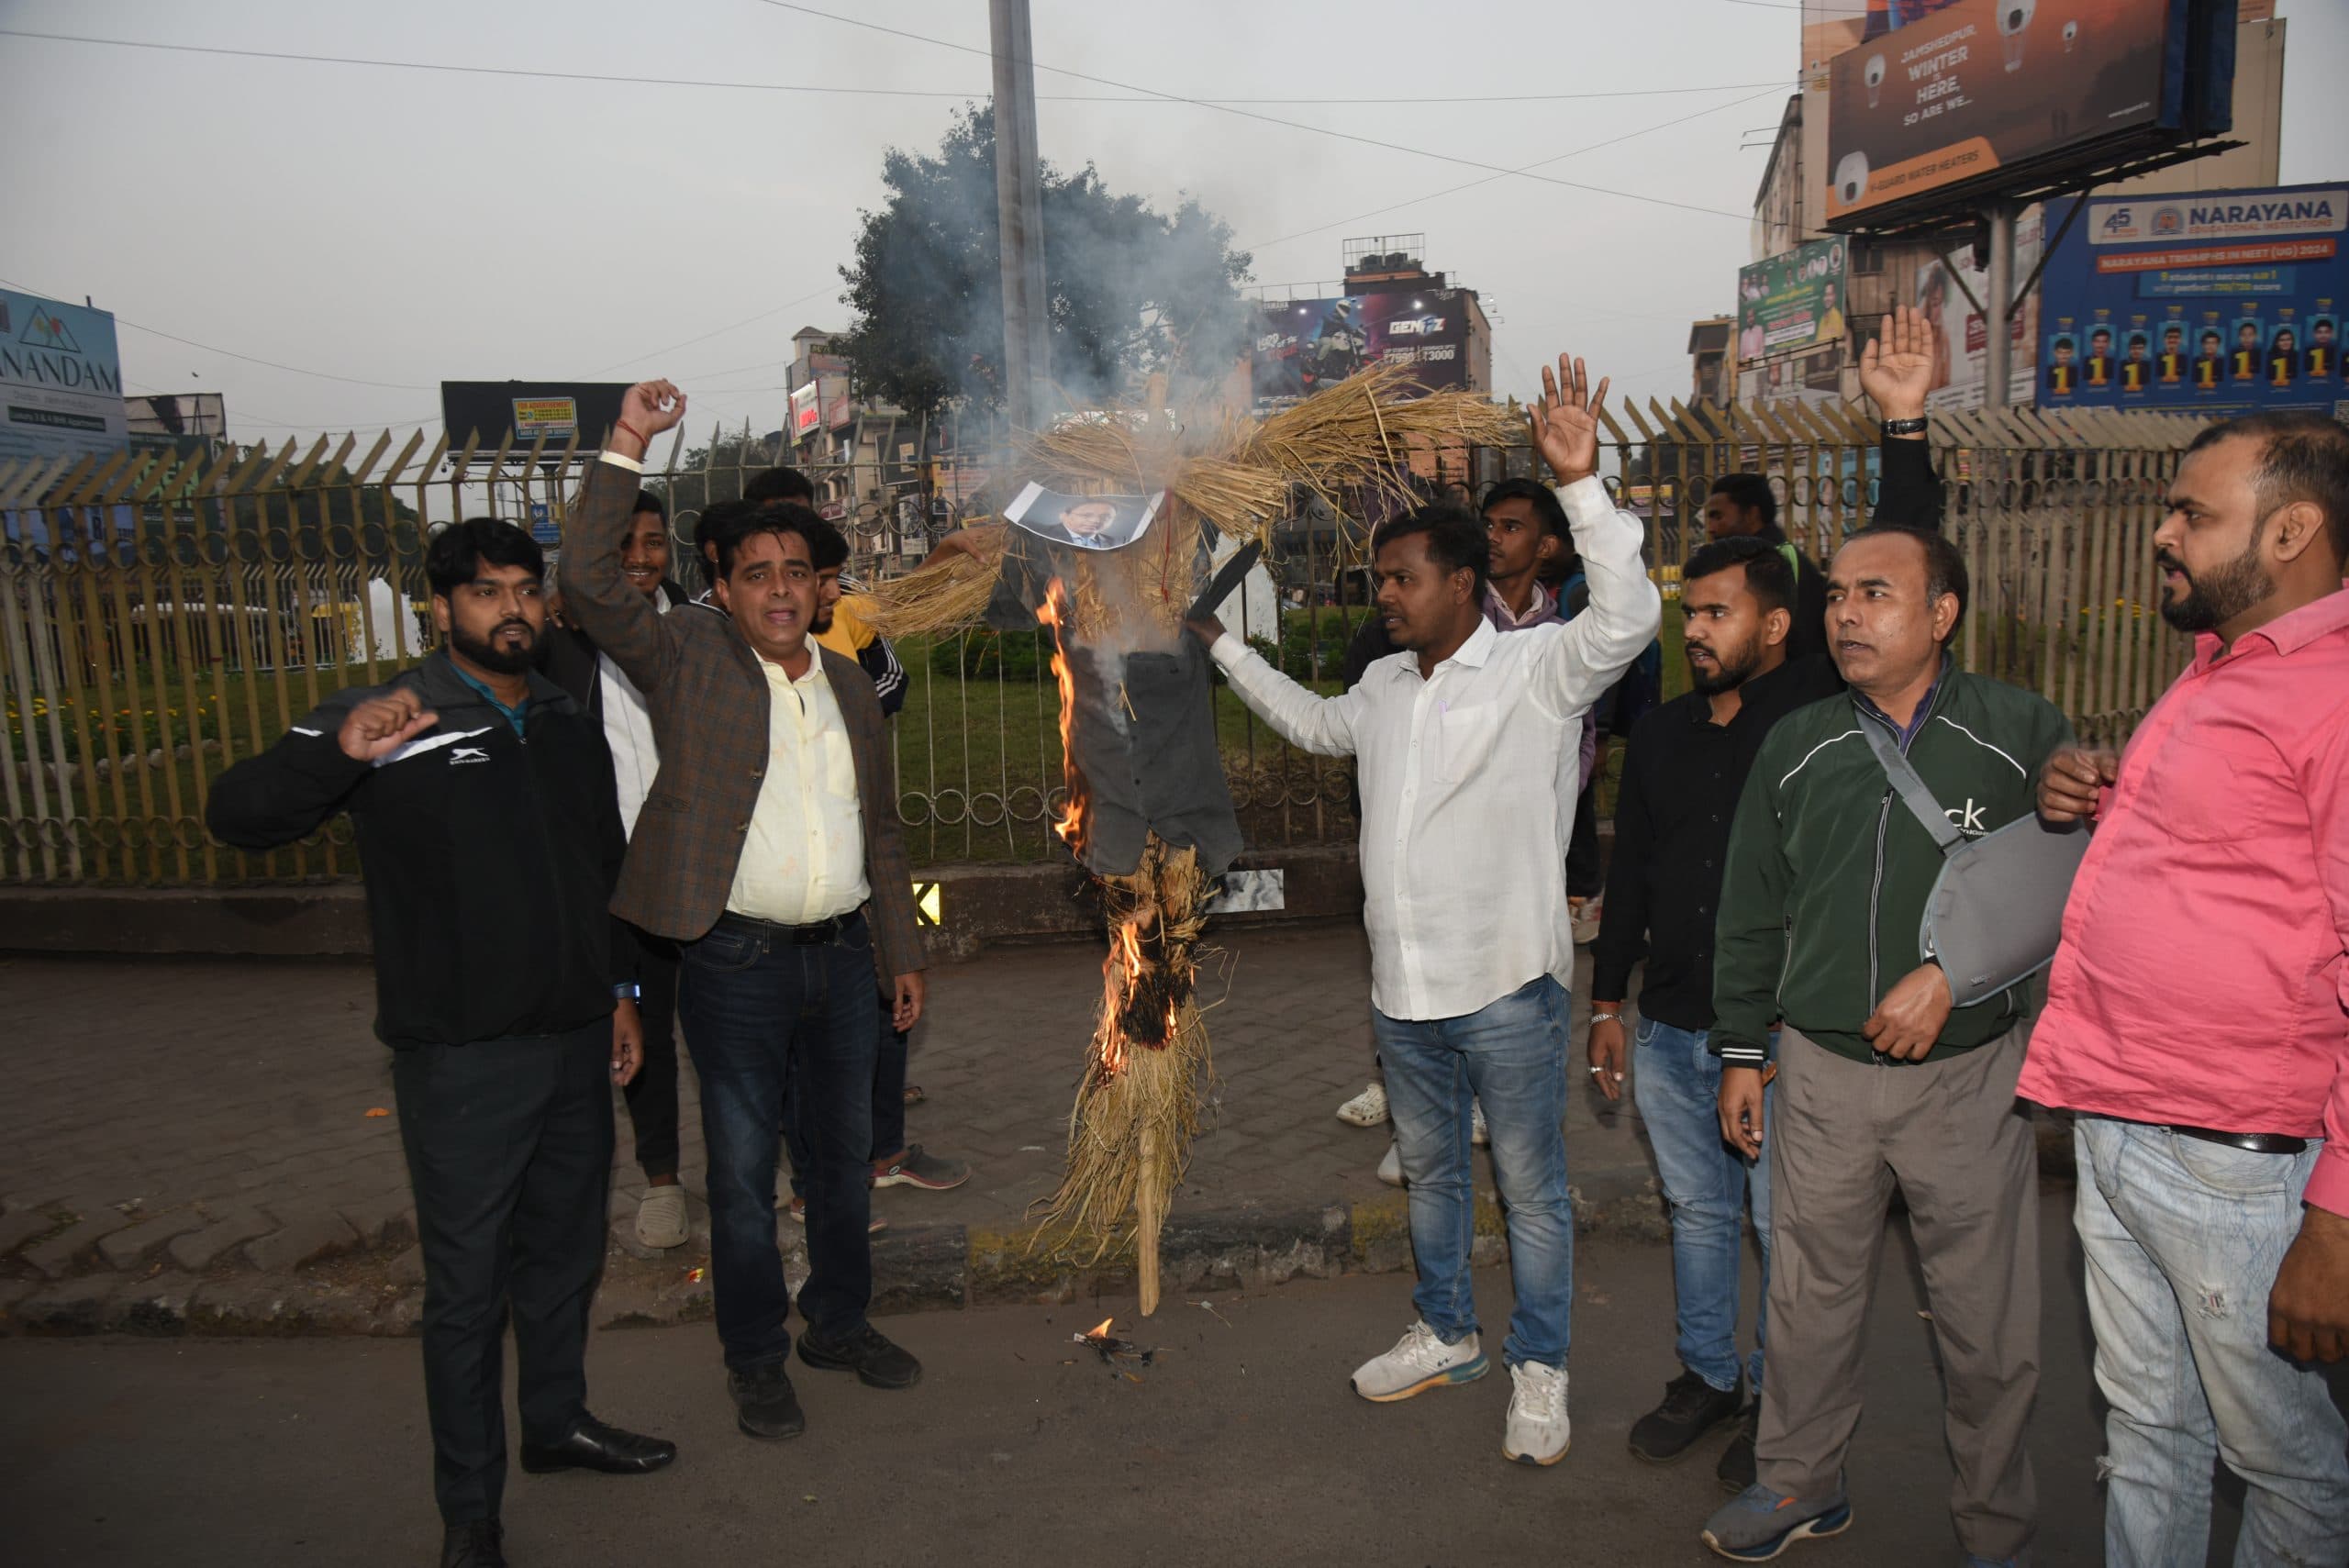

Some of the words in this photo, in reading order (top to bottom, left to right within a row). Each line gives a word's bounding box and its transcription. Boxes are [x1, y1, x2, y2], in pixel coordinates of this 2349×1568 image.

[1909, 45, 1968, 81] WINTER
[1904, 112, 1919, 126] SO
[1921, 103, 1943, 119] ARE
[1909, 164, 1937, 181] WATER
[1939, 150, 1979, 170] HEATERS
[2104, 208, 2132, 233] 45
[2189, 200, 2332, 225] NARAYANA
[2101, 255, 2166, 268] NARAYANA
[2168, 250, 2225, 263] TRIUMPHS
[2241, 248, 2269, 259] NEET
[2271, 245, 2298, 258] (UG)
[2299, 244, 2329, 255] 2024
[0, 345, 120, 394] NANDAM
[2053, 366, 2070, 395] 1
[2088, 357, 2107, 385] 1
[2123, 362, 2143, 391] 1
[2161, 353, 2180, 382] 1
[2197, 361, 2217, 389] 1
[2233, 350, 2254, 379] 1
[2271, 357, 2290, 386] 1
[2308, 348, 2328, 376] 1
[529, 401, 571, 409] ADVERTISEMENT
